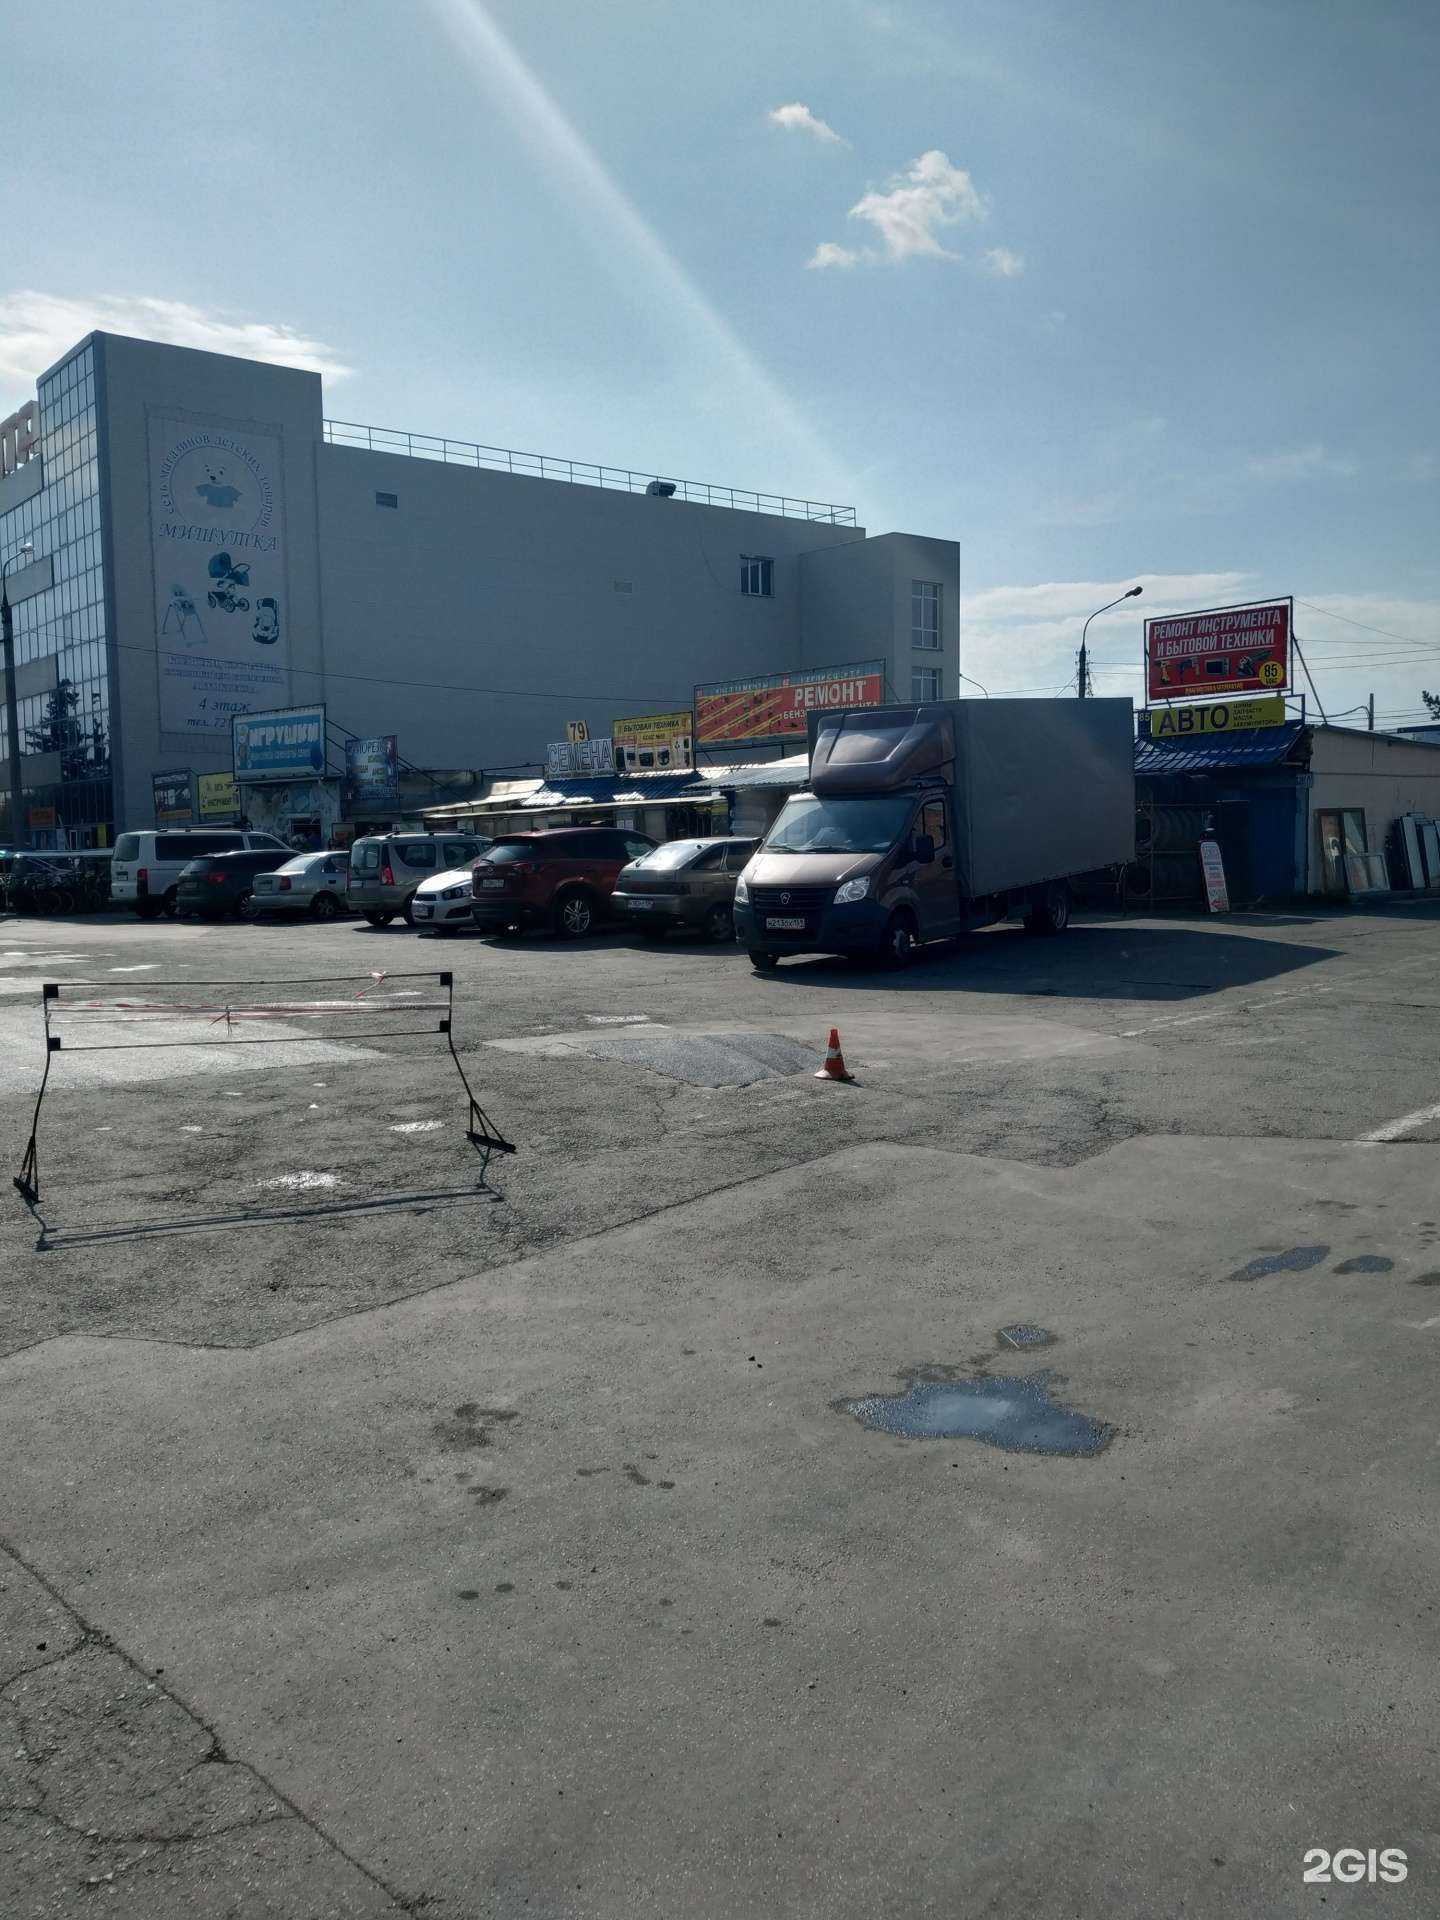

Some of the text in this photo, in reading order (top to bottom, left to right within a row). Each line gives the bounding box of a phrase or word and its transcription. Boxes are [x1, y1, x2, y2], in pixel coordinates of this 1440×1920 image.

[1154, 609, 1281, 640] РЕМОНТ ИНСТРУМЕНТА
[1157, 628, 1275, 657] И БЫТОВОЙ ТЕХНИКИ
[1264, 663, 1278, 678] 85
[199, 697, 252, 712] 4 этаж
[793, 680, 867, 707] РЕМОНТ
[1138, 713, 1150, 722] 85
[1158, 704, 1230, 735] АВТО
[249, 723, 319, 746] ИГРУШКИ
[569, 722, 586, 741] 79
[549, 739, 614, 772] СЕМЕНА
